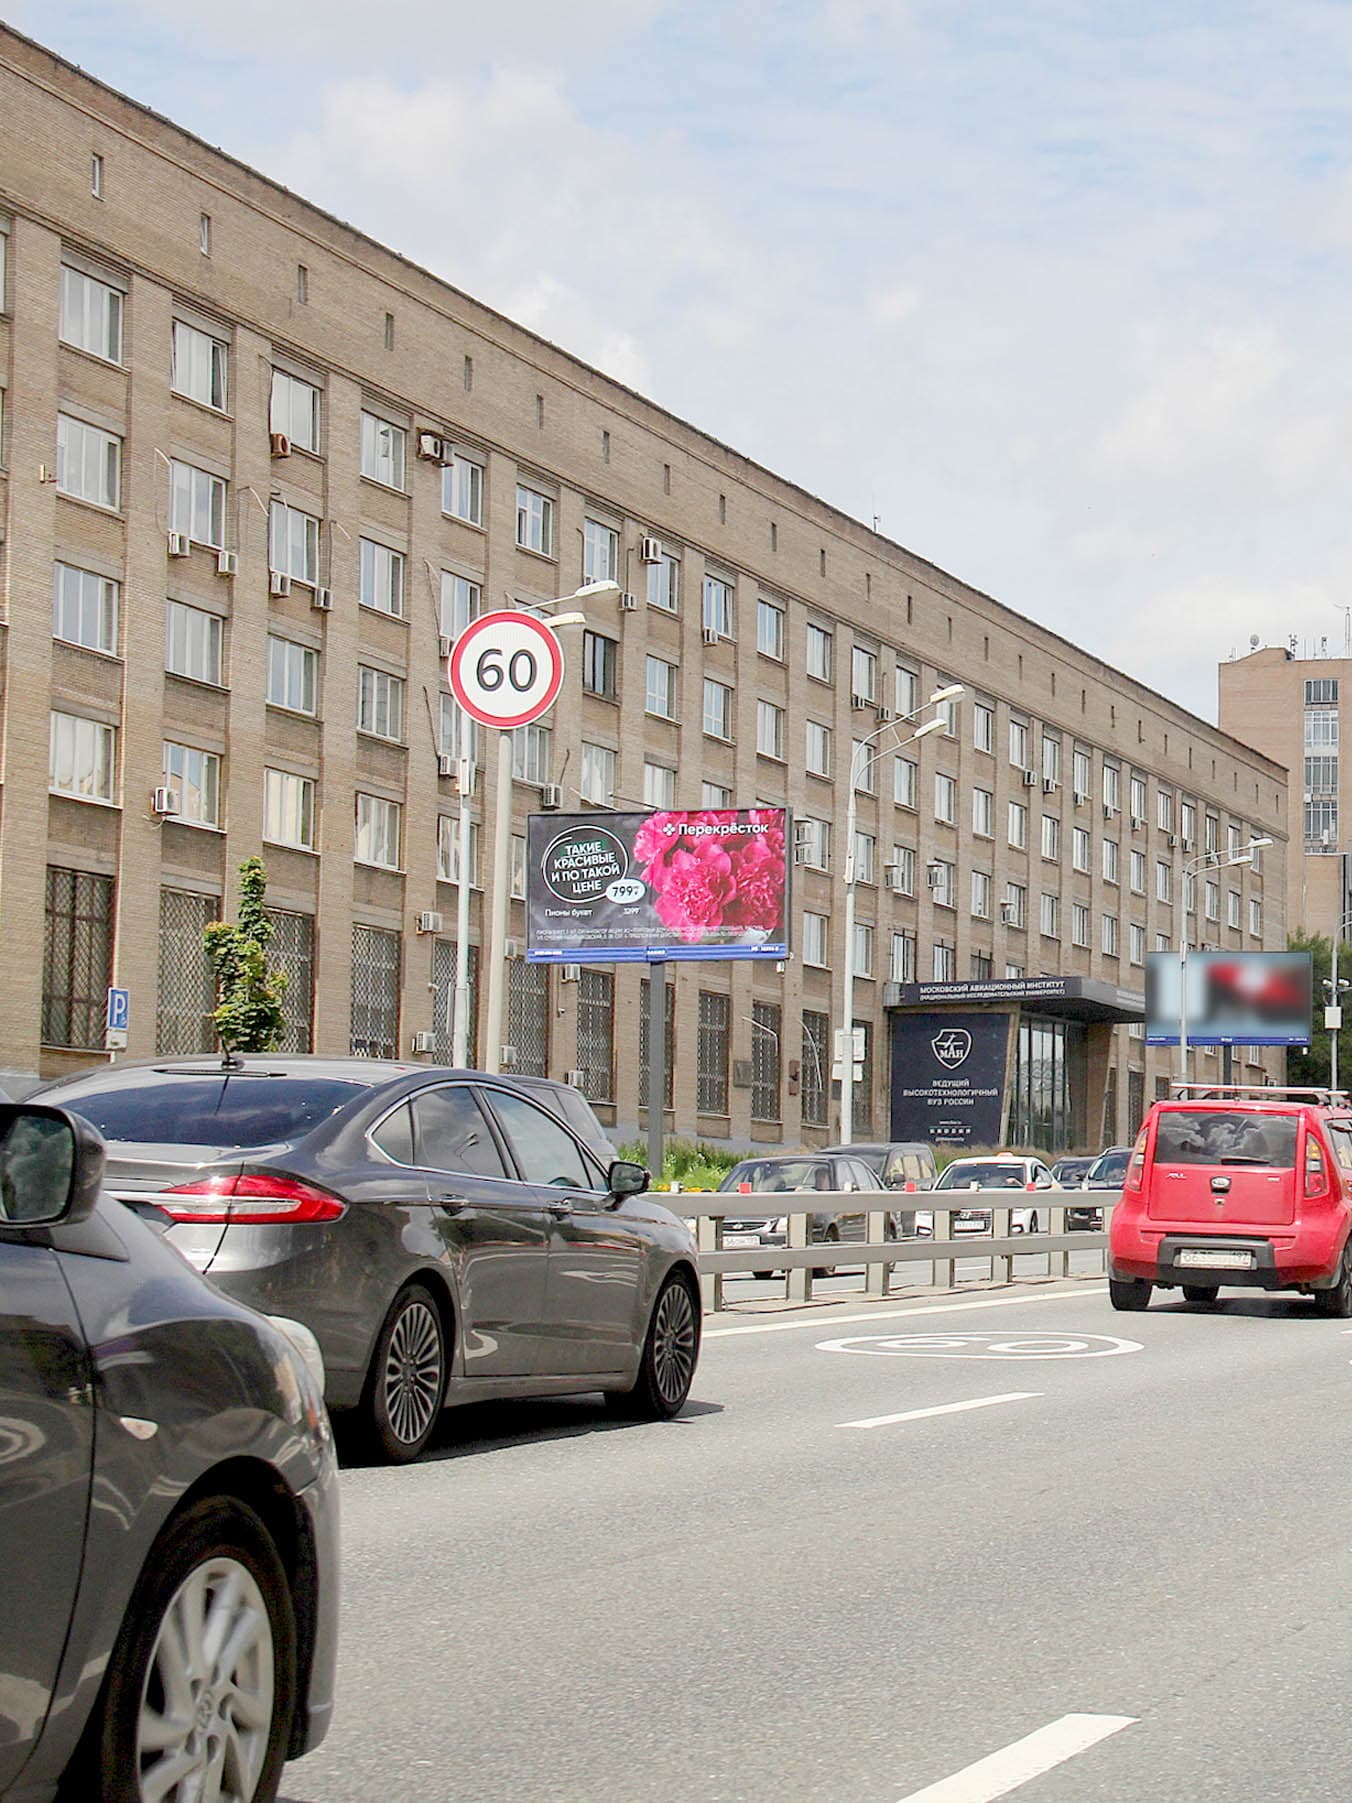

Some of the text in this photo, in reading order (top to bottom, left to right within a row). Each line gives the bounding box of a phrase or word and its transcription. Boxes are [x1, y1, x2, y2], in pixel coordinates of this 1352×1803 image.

[476, 648, 538, 692] 60
[678, 822, 769, 837] Перекрёсток
[565, 841, 602, 856] ТАКИЕ
[554, 852, 616, 870] КРАСИВЫЕ
[551, 863, 620, 883] И ПО ТАКОЙ
[572, 880, 602, 894] ЦЕНЕ
[920, 980, 1065, 994] МОСКОВСКИЙ АВИАЦИОННЫЙ ИНСТИТУТ
[113, 993, 126, 1025] P
[932, 1078, 970, 1088] ВЕДУЩИЙ
[903, 1088, 998, 1097] ВЫСОКОТЕХНОЛОГИЧНЫЙ
[943, 1098, 975, 1106] РОССИИ
[876, 1336, 1090, 1353] 60
